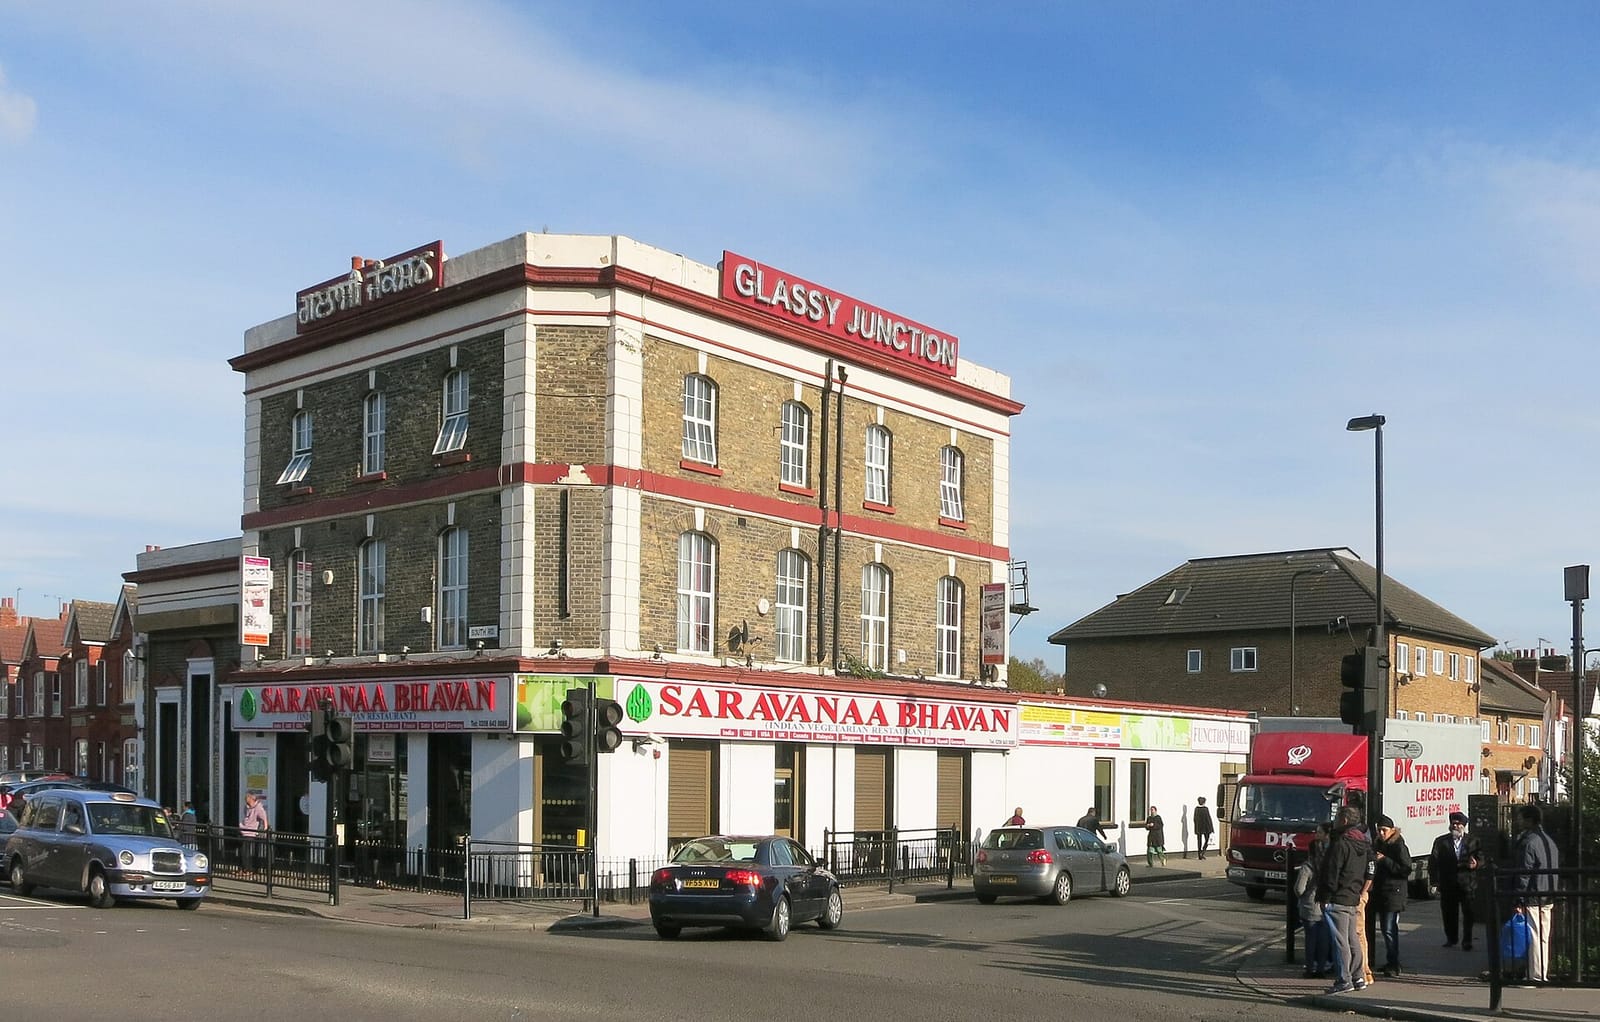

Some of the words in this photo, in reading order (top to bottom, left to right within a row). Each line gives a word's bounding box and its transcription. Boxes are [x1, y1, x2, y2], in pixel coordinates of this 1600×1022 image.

[734, 263, 842, 326] GLASSY
[845, 304, 957, 368] JUNCTION
[261, 683, 388, 713] SARAVANAA
[394, 680, 496, 712] BHAVAN
[659, 685, 889, 727] SARAVANAA
[896, 702, 1011, 732] BHAVAN
[765, 721, 805, 731] (INDIAN
[808, 723, 868, 734] VEGETARIAN
[1194, 727, 1229, 744] FUNCTION
[1230, 729, 1248, 745] HALL
[1394, 757, 1413, 783] DK
[1415, 763, 1475, 783] TRANSPORT
[1416, 787, 1454, 802] LEICESTER
[1407, 805, 1418, 818] TEL:
